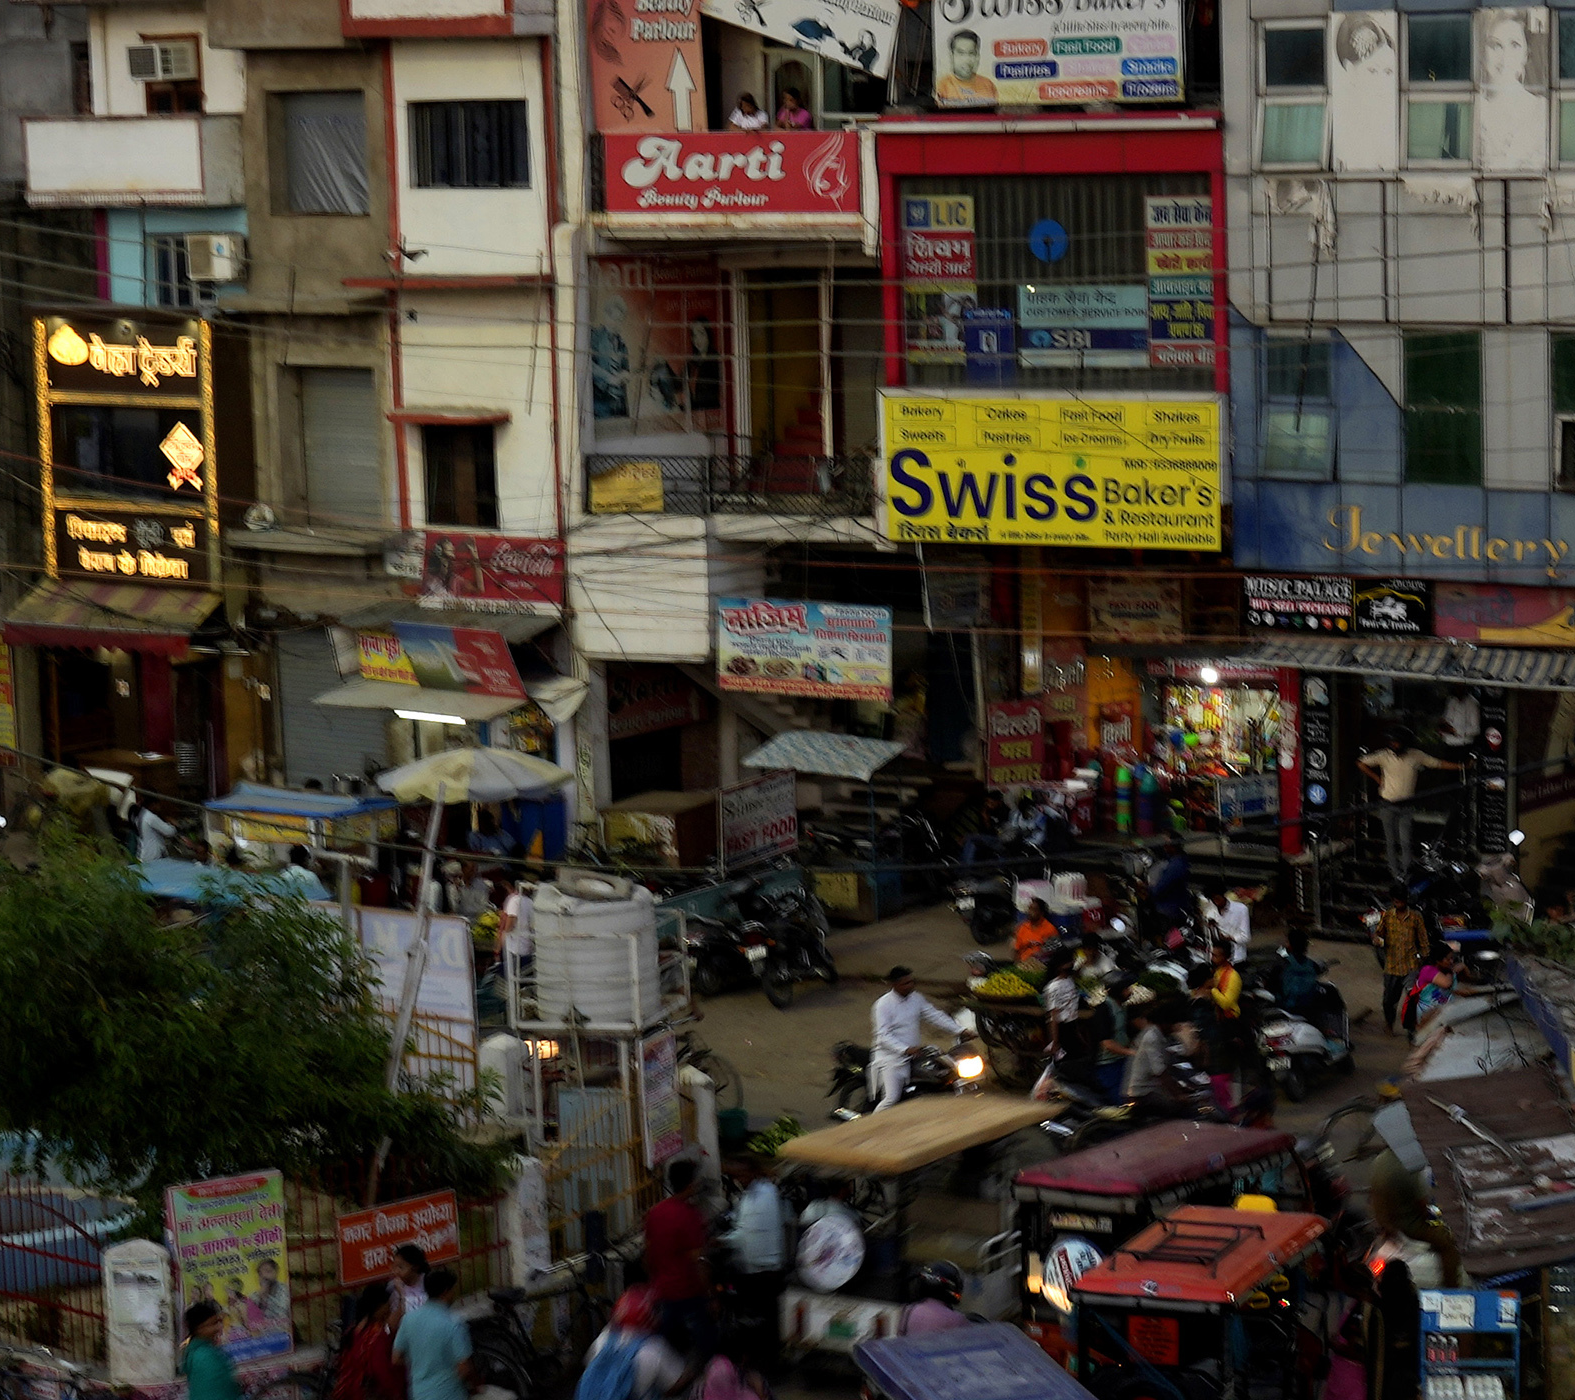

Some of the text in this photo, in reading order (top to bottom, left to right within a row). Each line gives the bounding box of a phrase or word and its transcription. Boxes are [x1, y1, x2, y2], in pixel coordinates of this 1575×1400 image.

[630, 17, 697, 42] Parlour
[621, 135, 787, 188] Aarti
[636, 184, 770, 210] Beauty Parlour
[933, 201, 968, 227] LIC
[1025, 307, 1121, 319] CUSTOMER SERVICE
[1052, 329, 1093, 349] SBI
[900, 405, 945, 422] Bakery
[986, 405, 1028, 423] Cakes
[1093, 408, 1123, 424] Food
[1152, 409, 1201, 425] Shakes
[899, 427, 947, 443] Sweets
[982, 429, 1033, 446] Pastries
[889, 447, 1216, 523] Swiss Baker's
[1119, 508, 1217, 529] Restaurant
[1104, 530, 1135, 547] Party
[1138, 530, 1161, 545] Hall
[1163, 531, 1217, 547] Available
[1324, 503, 1570, 581] Jewellery
[1243, 575, 1353, 600] MUSIC PALACE
[761, 815, 797, 842] FOOD
